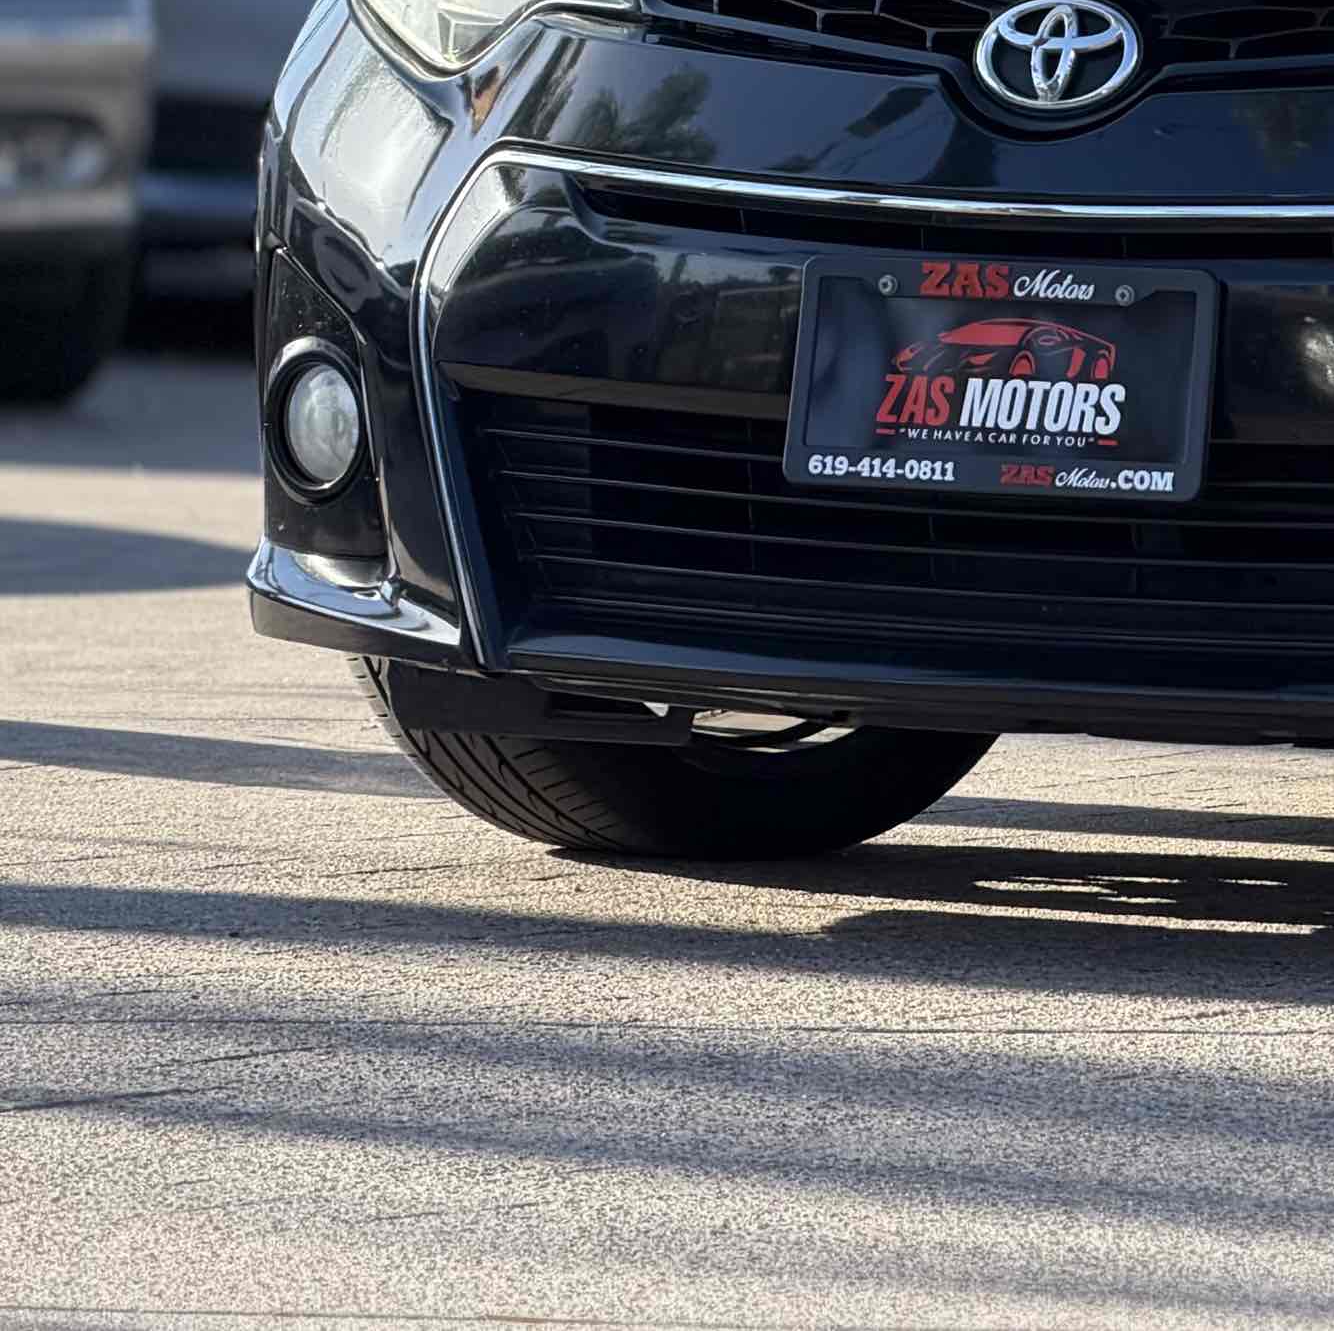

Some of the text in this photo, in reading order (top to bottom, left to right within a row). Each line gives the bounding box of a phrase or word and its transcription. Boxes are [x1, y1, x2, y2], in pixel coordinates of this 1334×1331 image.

[920, 261, 1095, 300] ZAS Motors
[876, 374, 1126, 435] ZAS MOTORS
[933, 429, 971, 442] HAVE
[974, 432, 984, 442] A
[988, 432, 1017, 443] CAR
[1022, 434, 1051, 445] FOR
[808, 454, 956, 481] 619-414-0811
[1001, 464, 1054, 487] ZAS
